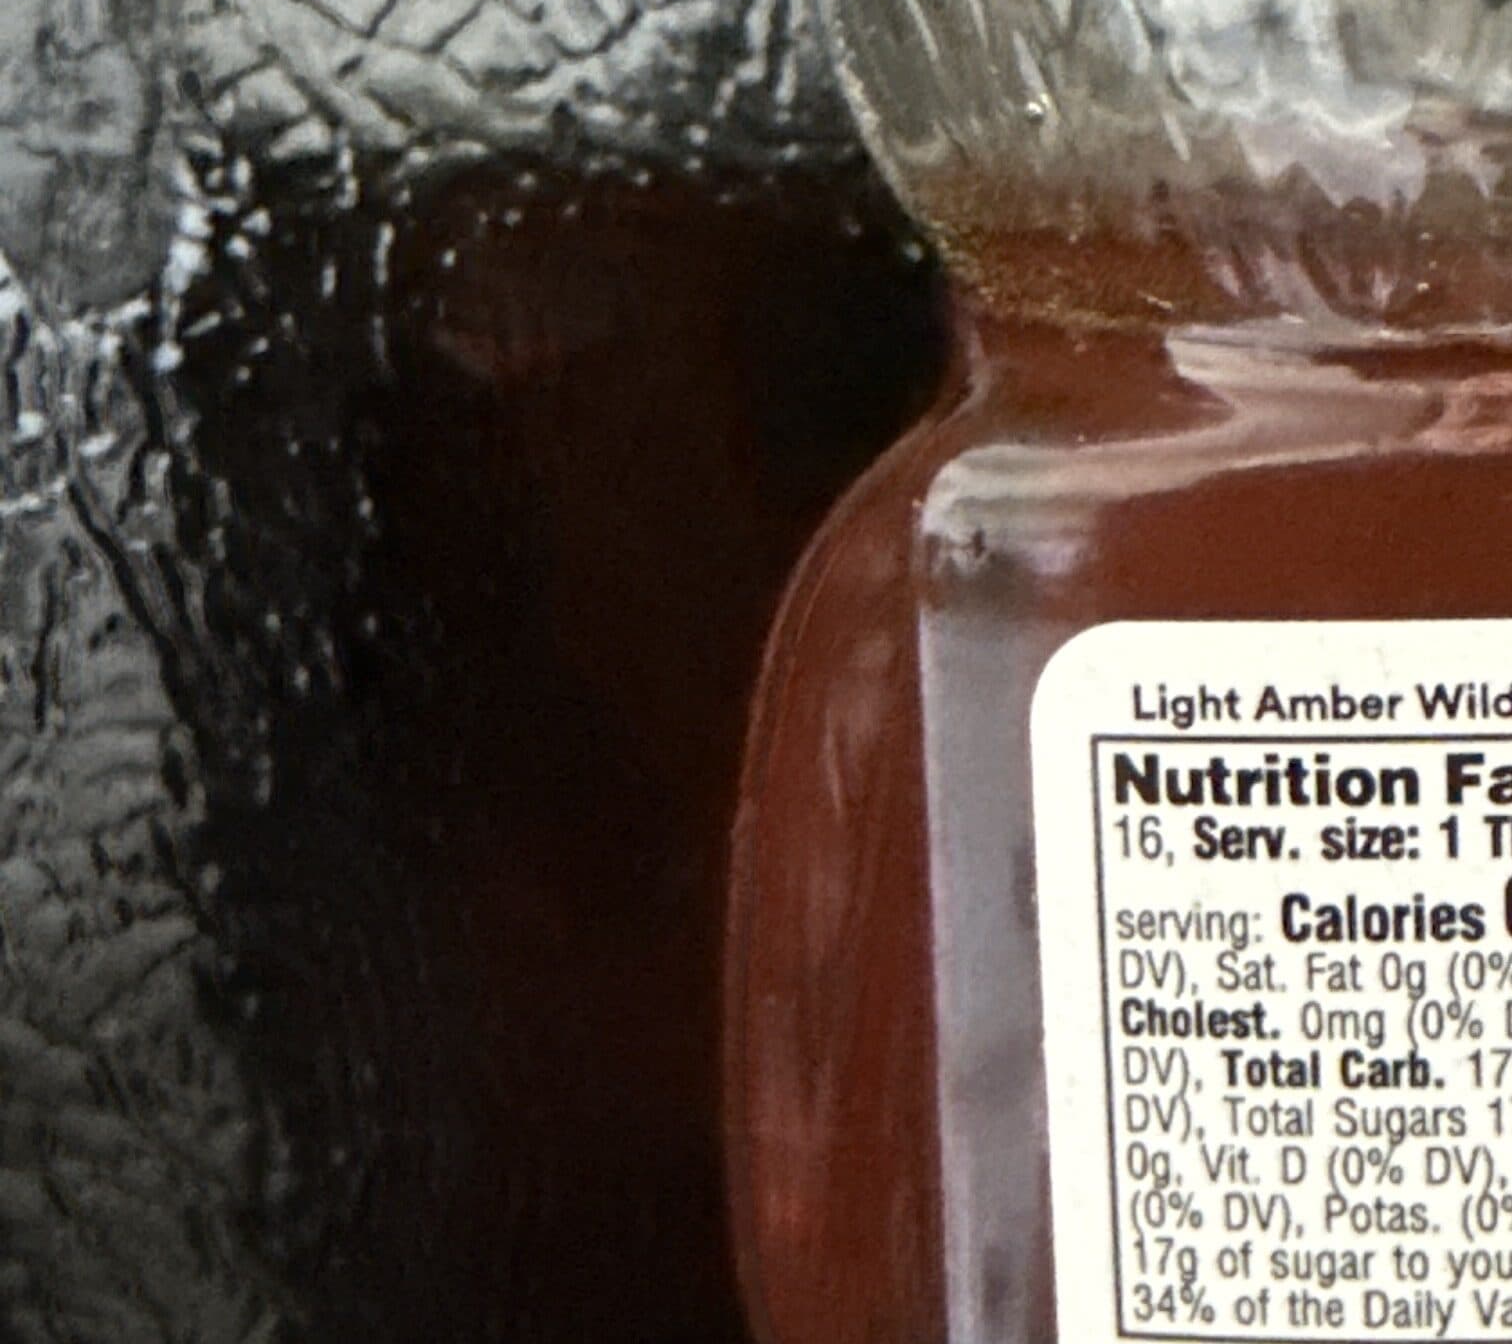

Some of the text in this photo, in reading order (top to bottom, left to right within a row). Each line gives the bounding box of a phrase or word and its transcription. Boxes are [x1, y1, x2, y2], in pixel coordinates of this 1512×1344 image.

[1133, 683, 1241, 729] Light
[1254, 684, 1403, 722] Amber
[1113, 753, 1420, 807] Nutrition
[1114, 815, 1175, 867] 16,
[1193, 815, 1300, 860] Serv.
[1321, 816, 1420, 860] size:
[1440, 815, 1459, 859] 1
[1116, 902, 1263, 950] serving:
[1281, 893, 1486, 943] Calories
[1120, 948, 1198, 999] DV),
[1216, 950, 1287, 993] Sat.
[1306, 951, 1362, 992] Fat
[1378, 950, 1427, 1002] 0g
[1121, 998, 1281, 1040] Cholest.
[1300, 1001, 1386, 1050] 0mg
[1408, 999, 1484, 1050] (0%
[1123, 1046, 1204, 1096] DV),
[1221, 1050, 1321, 1090] Total
[1340, 1049, 1446, 1090] Carb.
[1126, 1094, 1205, 1144] DV),
[1223, 1096, 1314, 1136] Total
[1334, 1097, 1467, 1146] Sugars
[1126, 1142, 1183, 1191] 0g,
[1201, 1145, 1260, 1185] Vit.
[1281, 1146, 1307, 1185] D
[1328, 1145, 1405, 1194] (0%
[1425, 1146, 1508, 1194] DV),
[1131, 1190, 1204, 1236] (0%
[1224, 1192, 1304, 1242] DV),
[1325, 1194, 1441, 1235] Potas.
[1134, 1237, 1198, 1286] 17g
[1217, 1240, 1252, 1278] of
[1270, 1248, 1375, 1288] sugar
[1393, 1246, 1429, 1280] to
[1133, 1283, 1216, 1325] 34%
[1234, 1288, 1271, 1327] of
[1288, 1289, 1345, 1328] the
[1363, 1290, 1455, 1337] Daily
